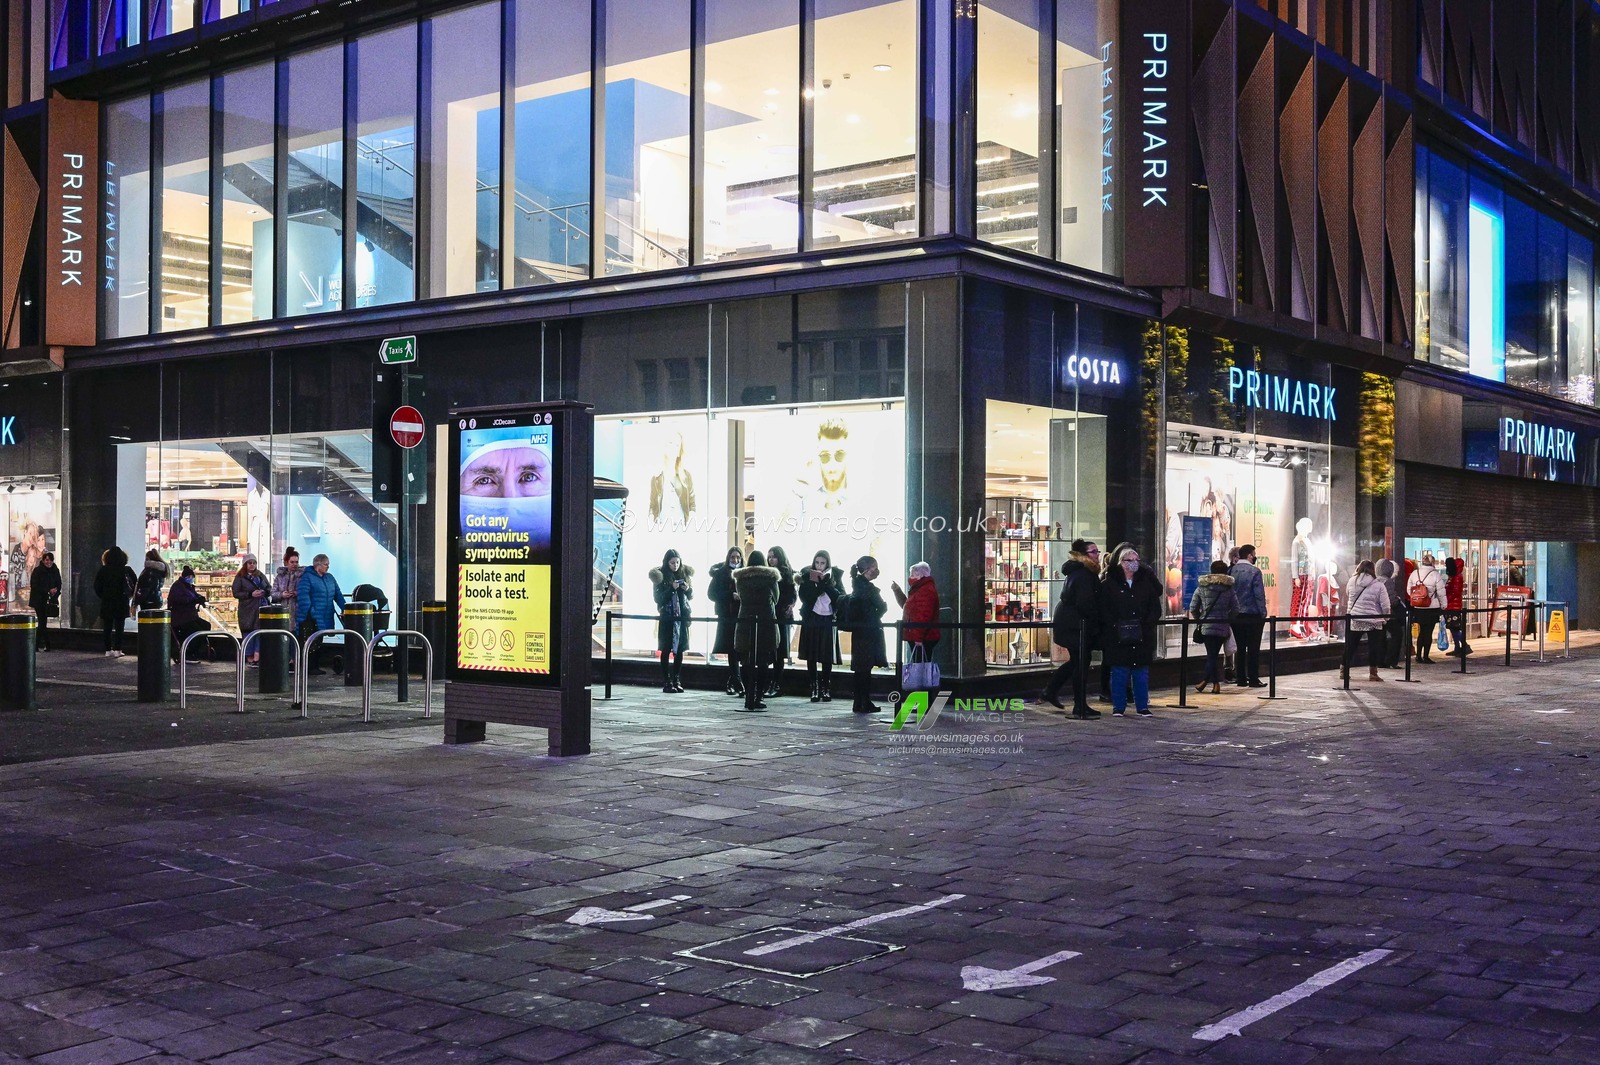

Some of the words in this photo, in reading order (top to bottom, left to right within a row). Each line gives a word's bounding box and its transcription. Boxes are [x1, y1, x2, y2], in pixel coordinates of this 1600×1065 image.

[1143, 33, 1167, 207] PRIMARK
[62, 154, 83, 286] PRIMARK
[388, 346, 404, 355] Taxis
[1067, 354, 1121, 385] COSTA
[1229, 366, 1336, 421] PRIMARK
[492, 418, 516, 426] JCDecaux
[531, 434, 548, 444] NHS
[1504, 417, 1576, 463] PRIMARK
[465, 514, 486, 527] Got
[488, 515, 509, 530] any
[465, 529, 529, 543] coronavirus
[465, 546, 530, 562] symptoms?
[465, 569, 502, 582] Isolate
[504, 569, 526, 583] and
[465, 585, 493, 599] book
[495, 588, 502, 599] a
[505, 587, 529, 600] test.
